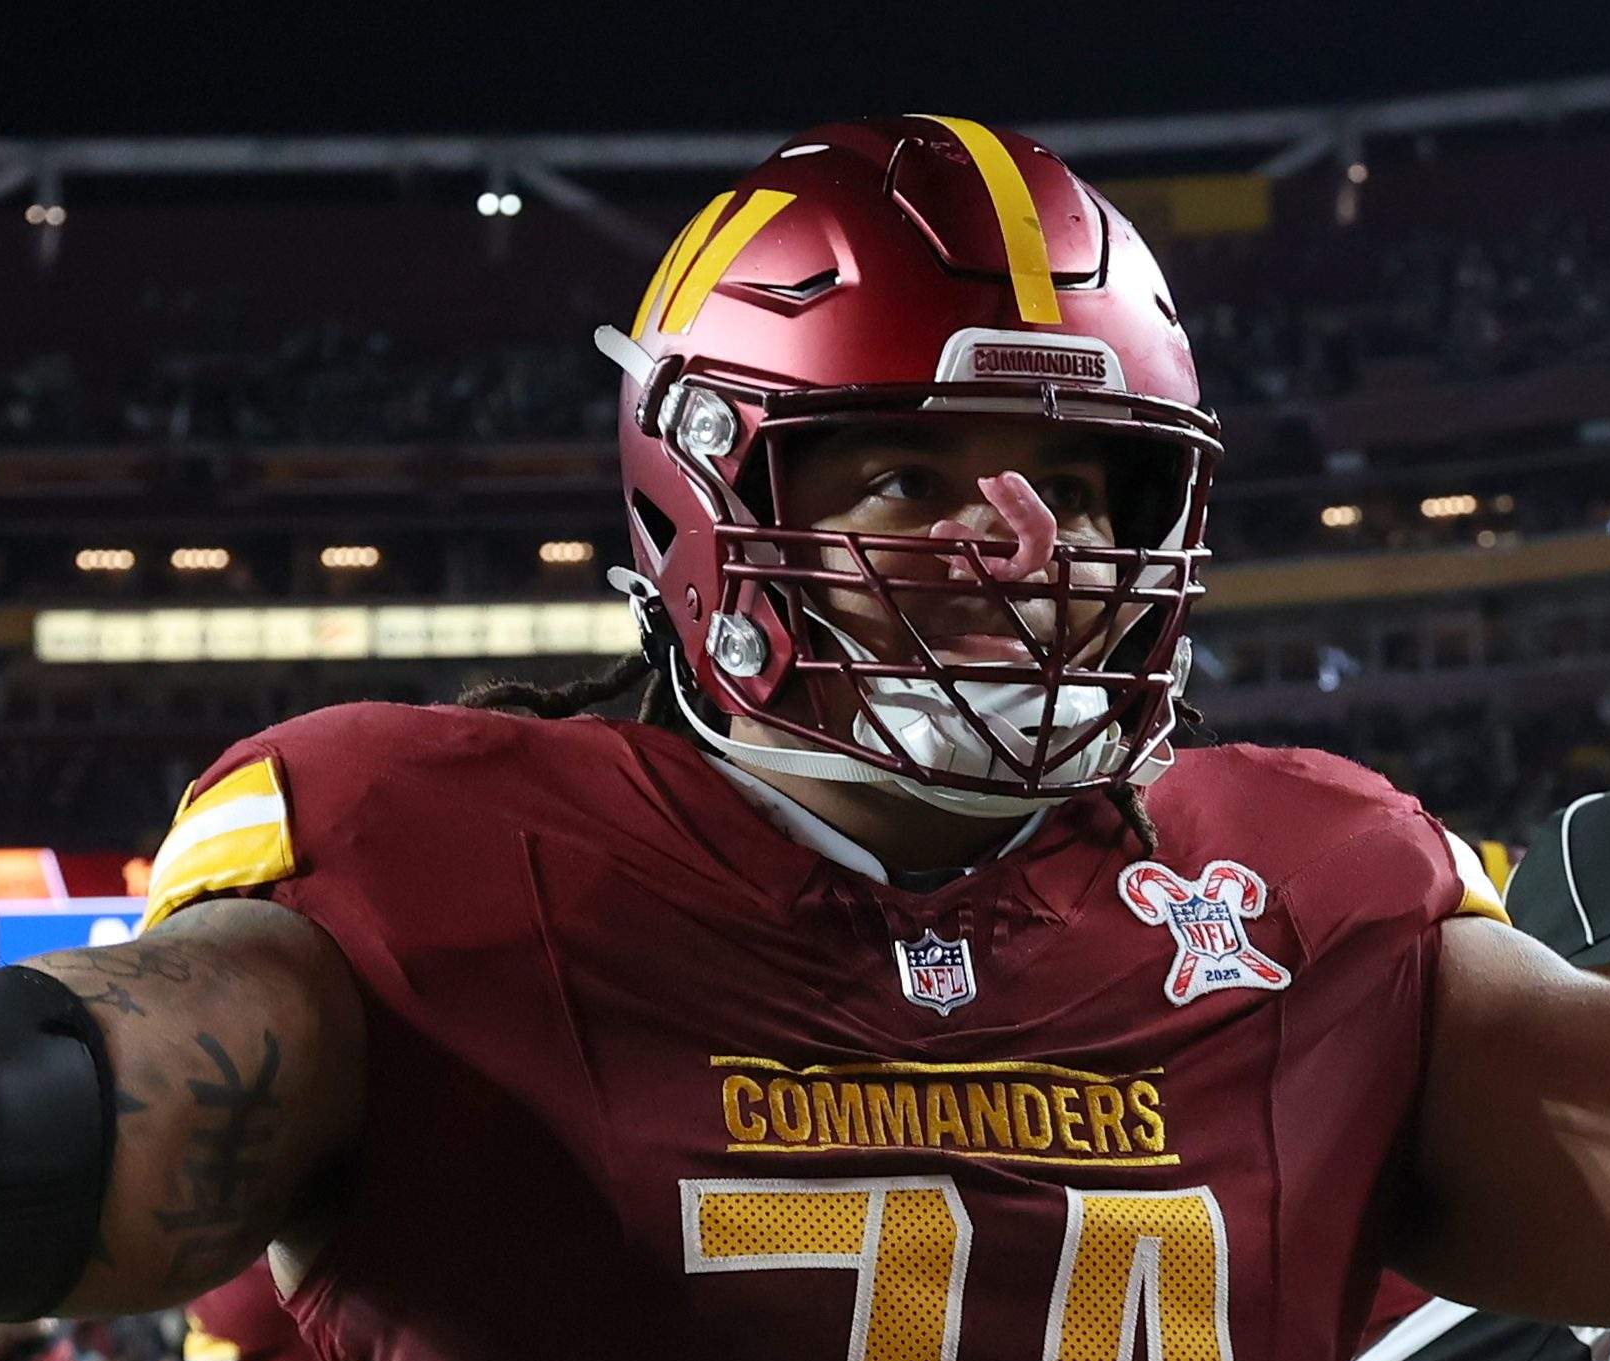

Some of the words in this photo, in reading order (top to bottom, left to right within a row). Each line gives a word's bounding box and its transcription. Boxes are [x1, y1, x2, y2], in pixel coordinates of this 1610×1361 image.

[973, 346, 1106, 380] COMMANDERS
[1185, 920, 1236, 953] NFL
[914, 967, 964, 999] NFL
[1204, 967, 1241, 984] 2025
[722, 1073, 1166, 1155] COMMANDERS
